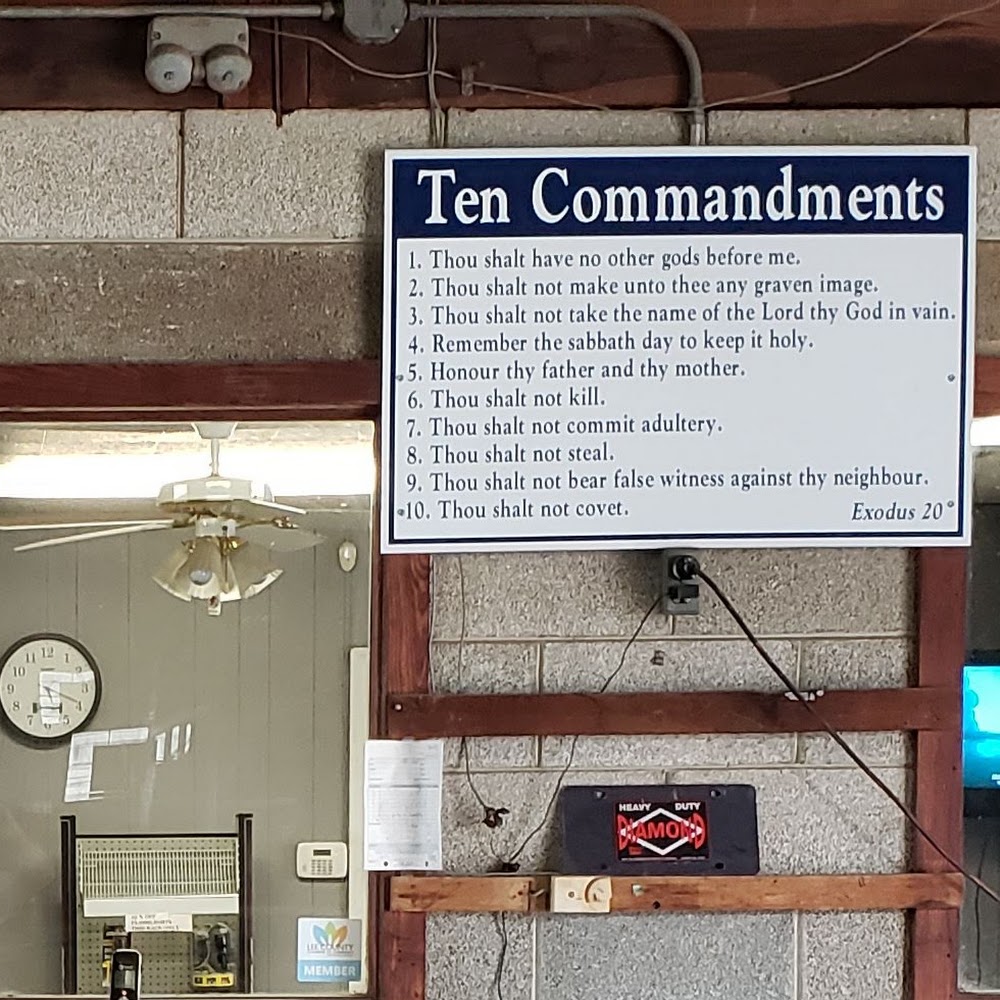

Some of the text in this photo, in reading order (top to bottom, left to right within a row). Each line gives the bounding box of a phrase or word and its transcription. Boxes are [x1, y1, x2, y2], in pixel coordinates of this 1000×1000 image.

[416, 163, 946, 225] Ten Commandments
[409, 245, 801, 271] 1. Thou shalt have no other gods before me.
[408, 273, 878, 298] 2. Thou shalt not make unto thee any graven image.
[408, 300, 956, 326] 3. Thou shalt not take the name of the Lord thy God in vain.
[408, 328, 813, 355] 4. Remember the sabbath day to keep it holy.
[408, 356, 745, 384] 5. Honour thy father and thy mother.
[406, 412, 722, 438] 7. Thou shalt not commit adultery.
[406, 465, 929, 492] 9. Thou shalt not bear false witness against thy neighbour.
[851, 502, 944, 522] Exodus 20
[618, 802, 701, 812] HEAVY DUTY
[303, 965, 356, 976] MEMBER
